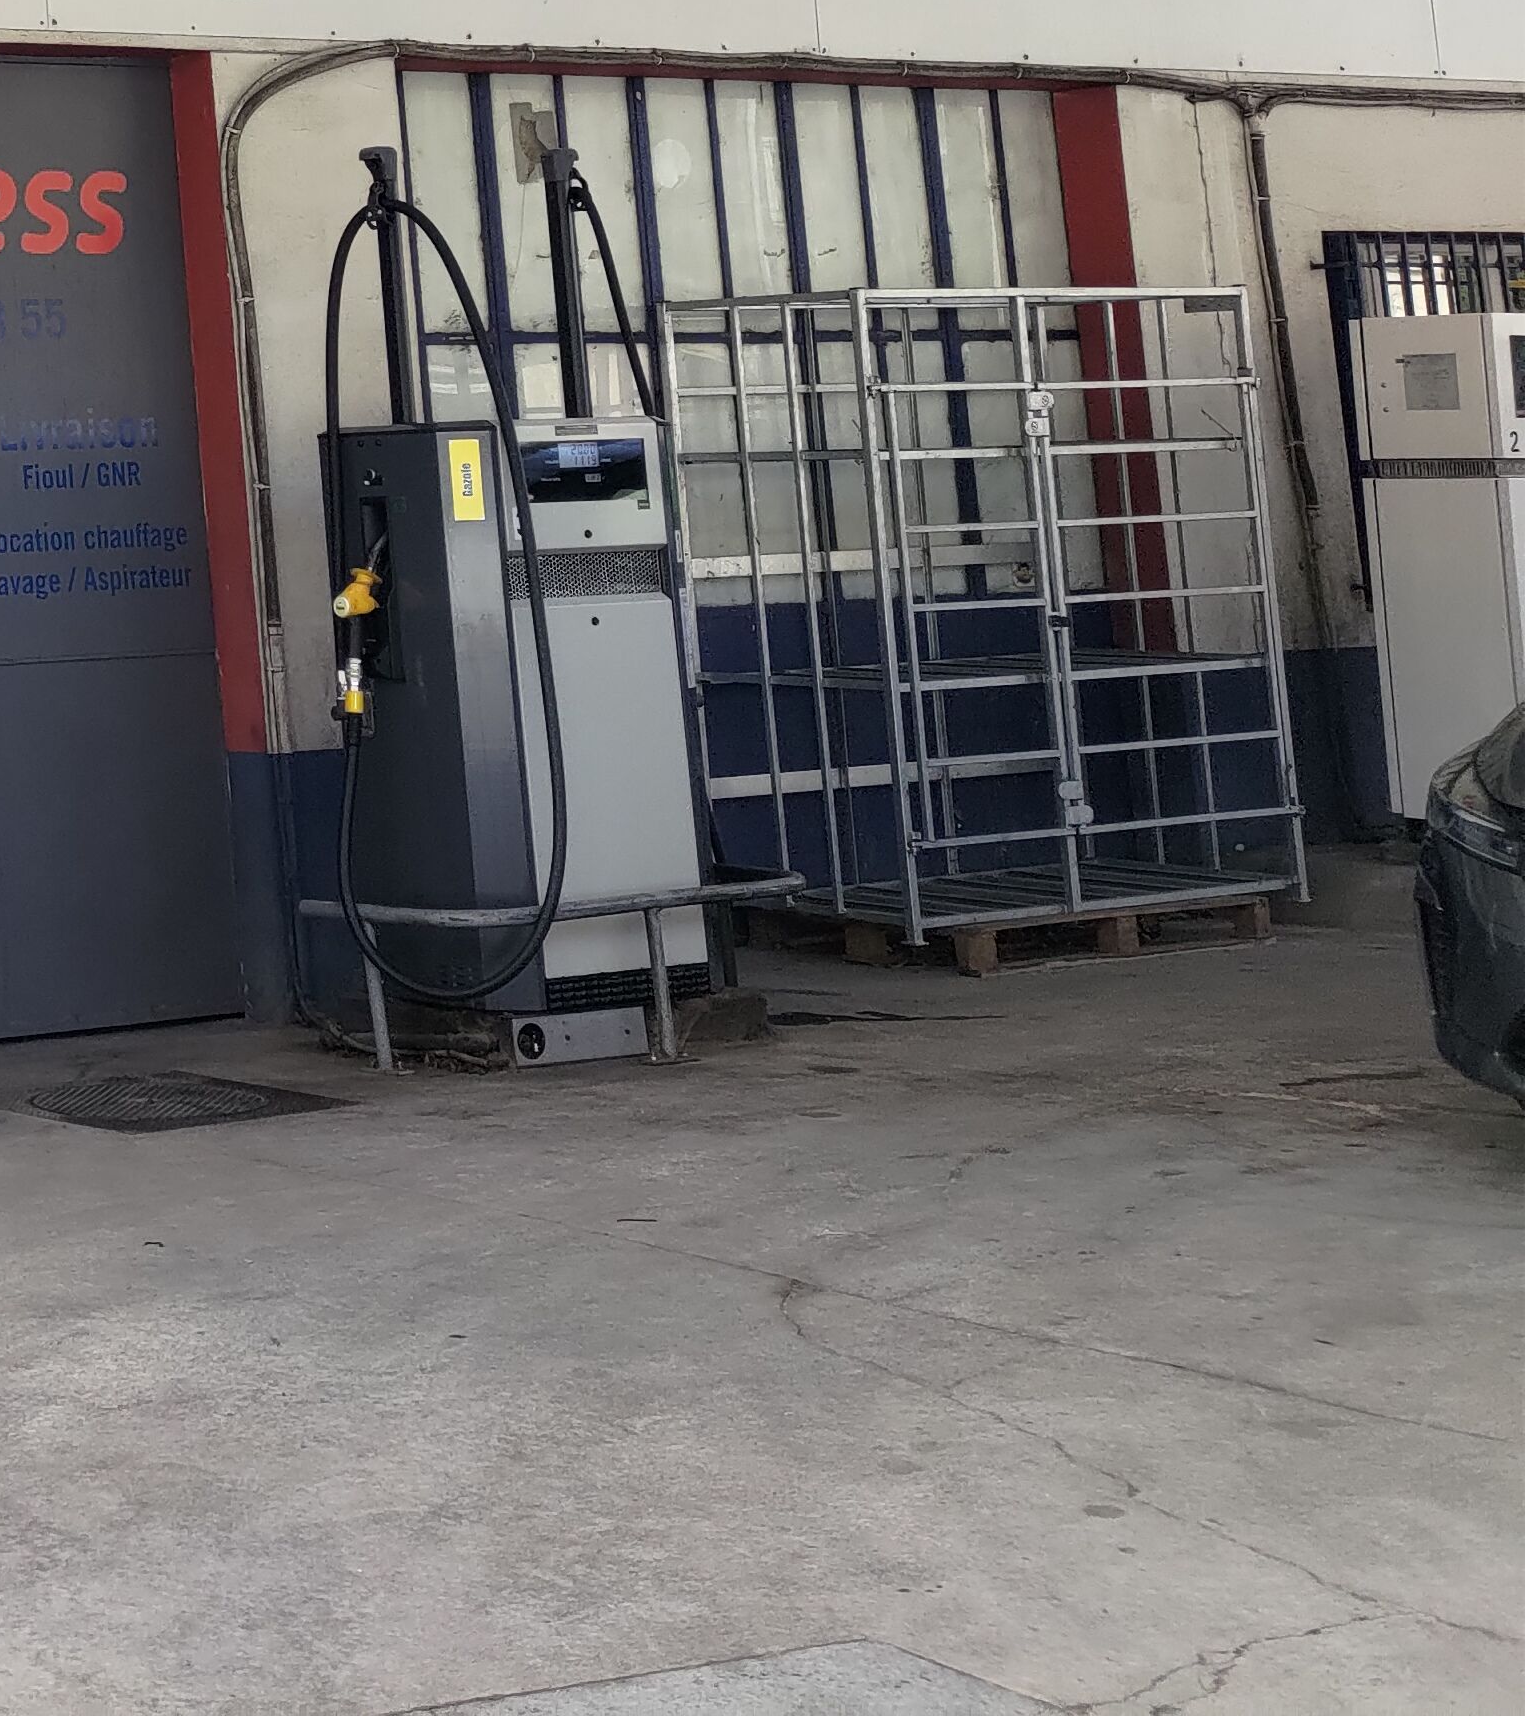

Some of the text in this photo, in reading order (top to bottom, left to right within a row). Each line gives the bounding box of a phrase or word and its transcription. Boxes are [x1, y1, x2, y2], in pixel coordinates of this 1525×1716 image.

[20, 298, 67, 339] 55
[1510, 431, 1520, 452] 2
[22, 464, 74, 490] Fioul
[97, 461, 141, 486] GNR
[84, 523, 189, 552] chauffage
[84, 564, 192, 596] Aspirateur
